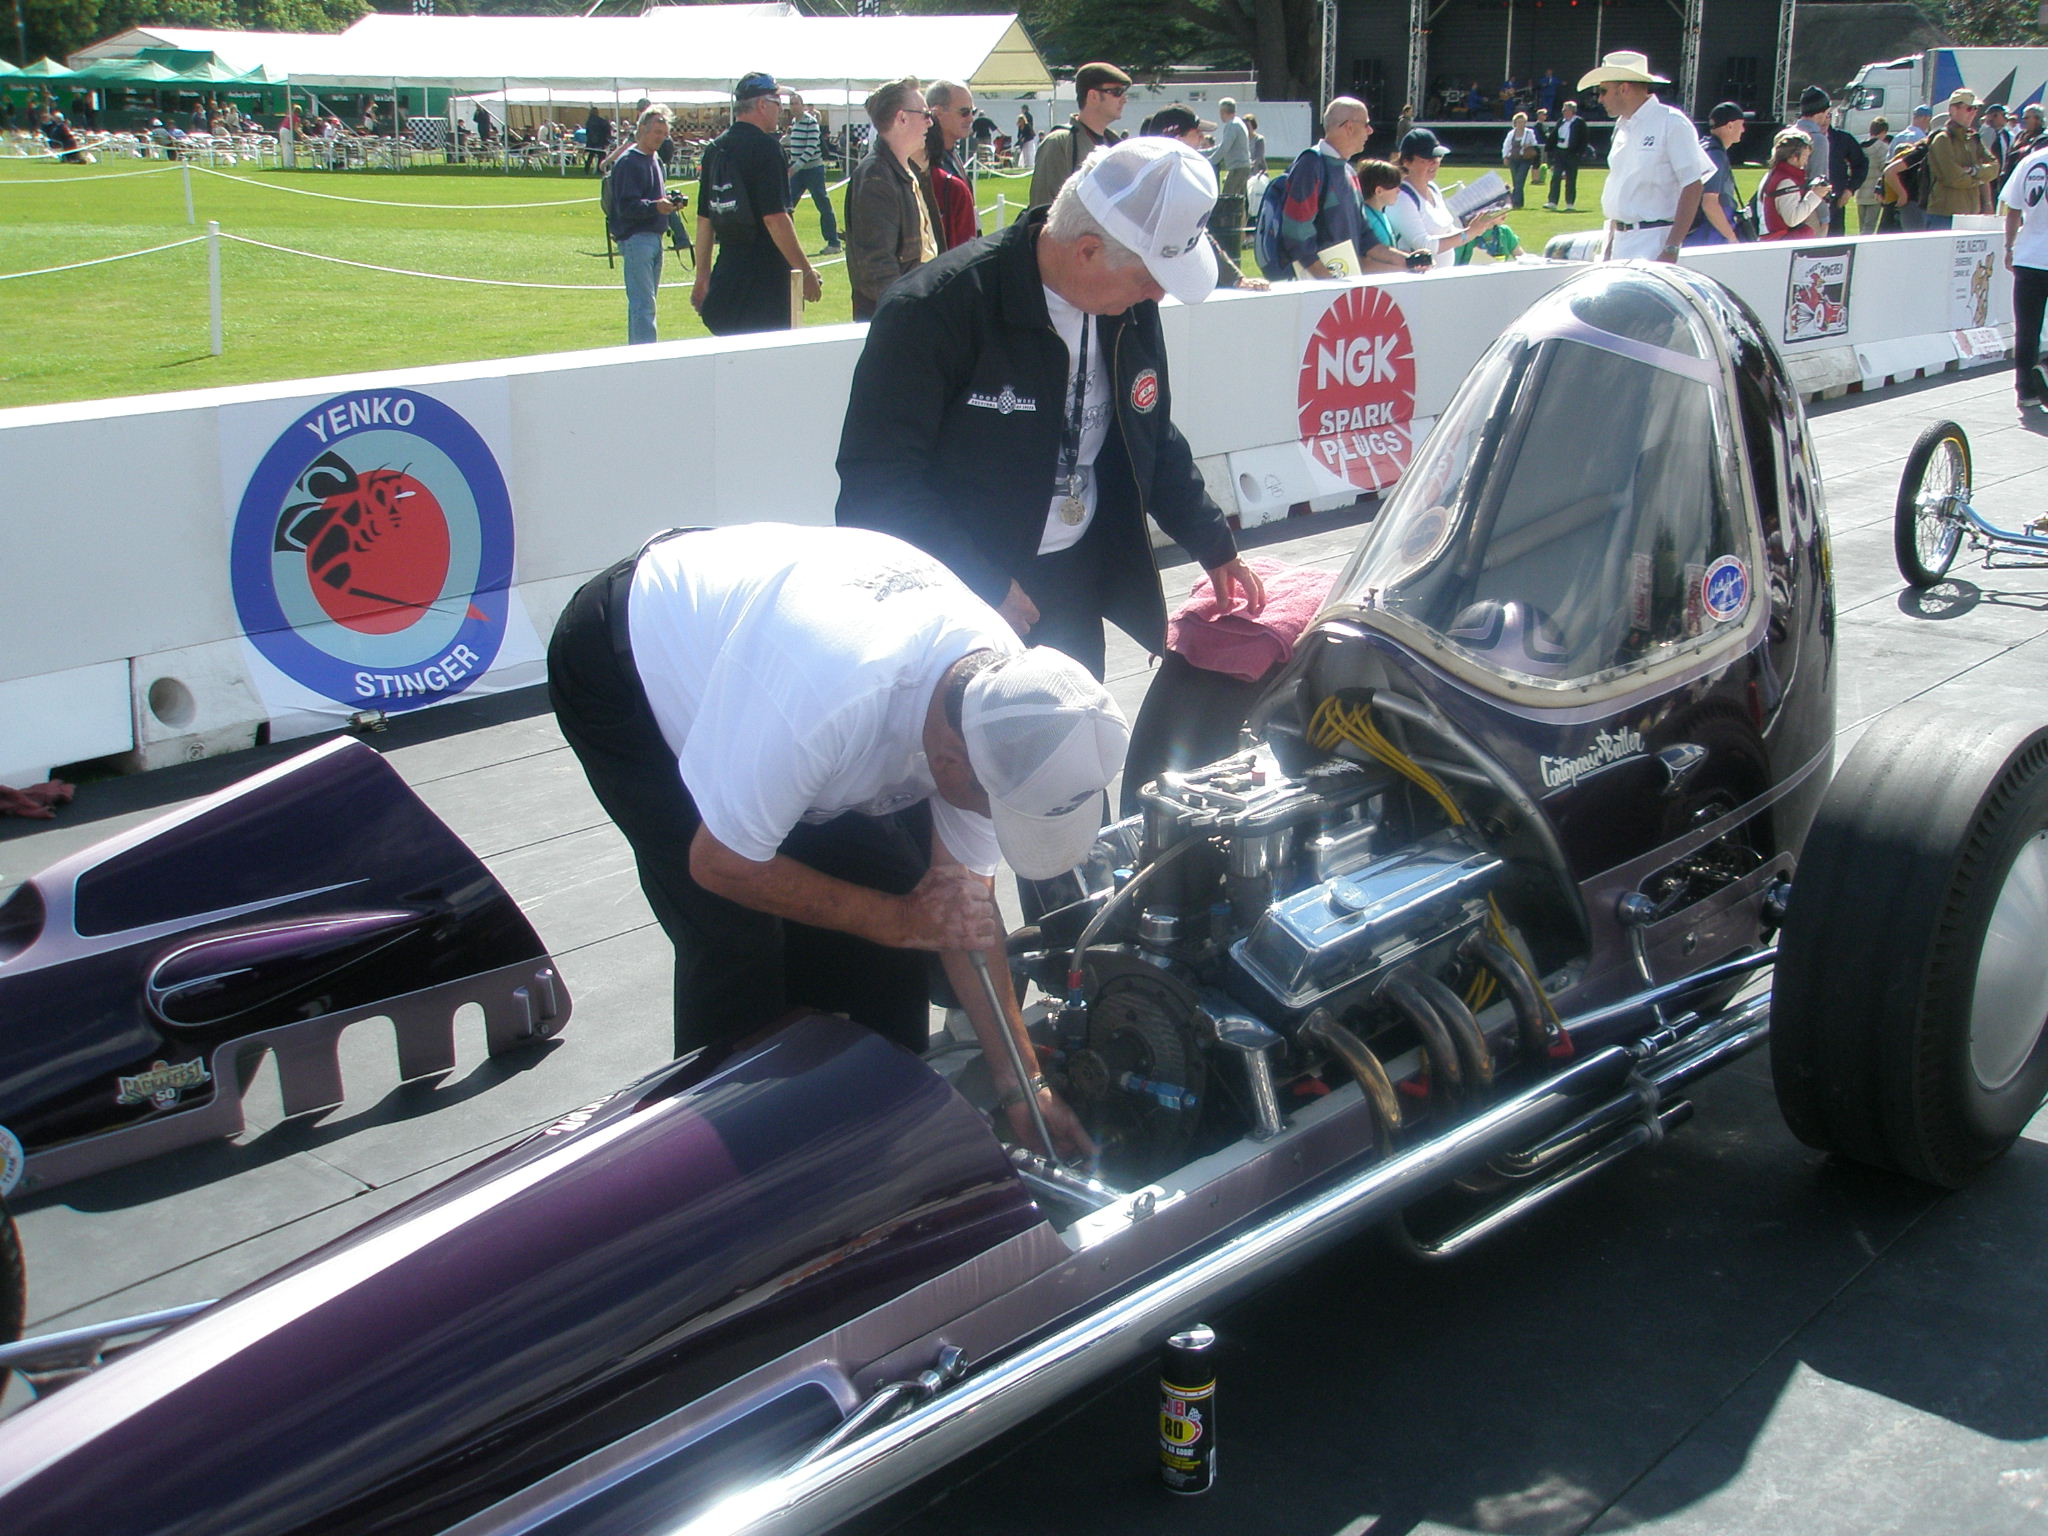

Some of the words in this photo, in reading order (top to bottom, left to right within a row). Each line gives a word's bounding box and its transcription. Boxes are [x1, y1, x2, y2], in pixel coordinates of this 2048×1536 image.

[1317, 334, 1398, 390] NGK
[306, 397, 415, 443] YENKO
[1318, 401, 1394, 436] SPARK
[1320, 430, 1402, 465] PLUGS
[355, 644, 480, 698] STINGER
[156, 1088, 175, 1100] 50
